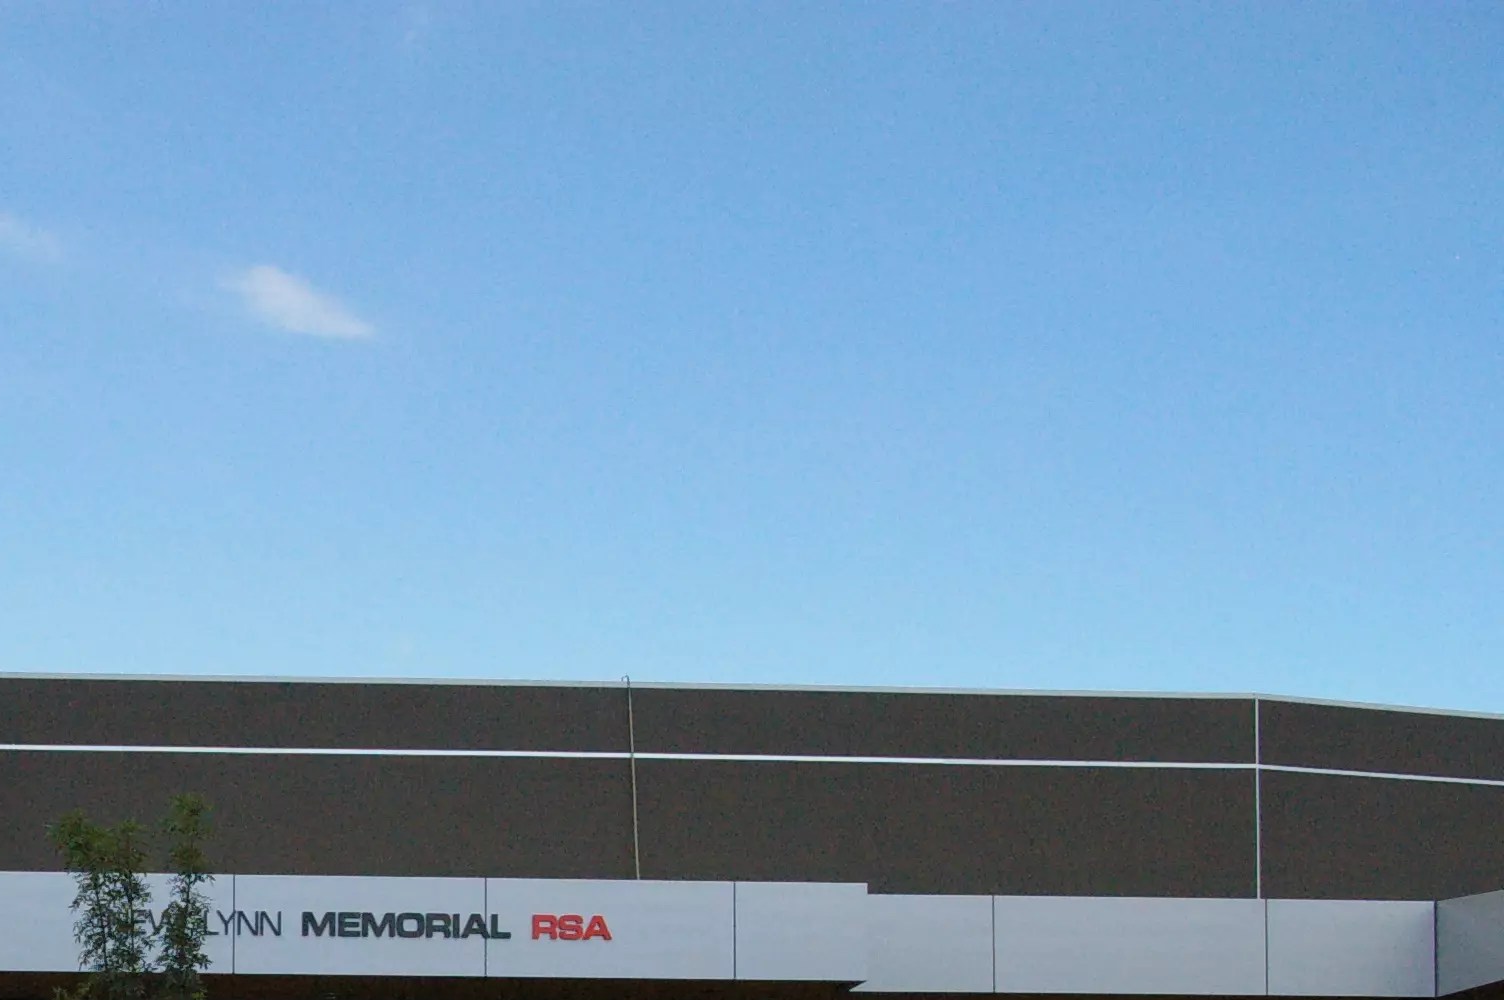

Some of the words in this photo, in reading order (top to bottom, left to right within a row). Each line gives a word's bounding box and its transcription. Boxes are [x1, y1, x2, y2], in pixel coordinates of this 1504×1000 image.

[203, 910, 283, 936] LYNN
[301, 911, 512, 940] MEMORIAL
[531, 914, 613, 941] RSA
